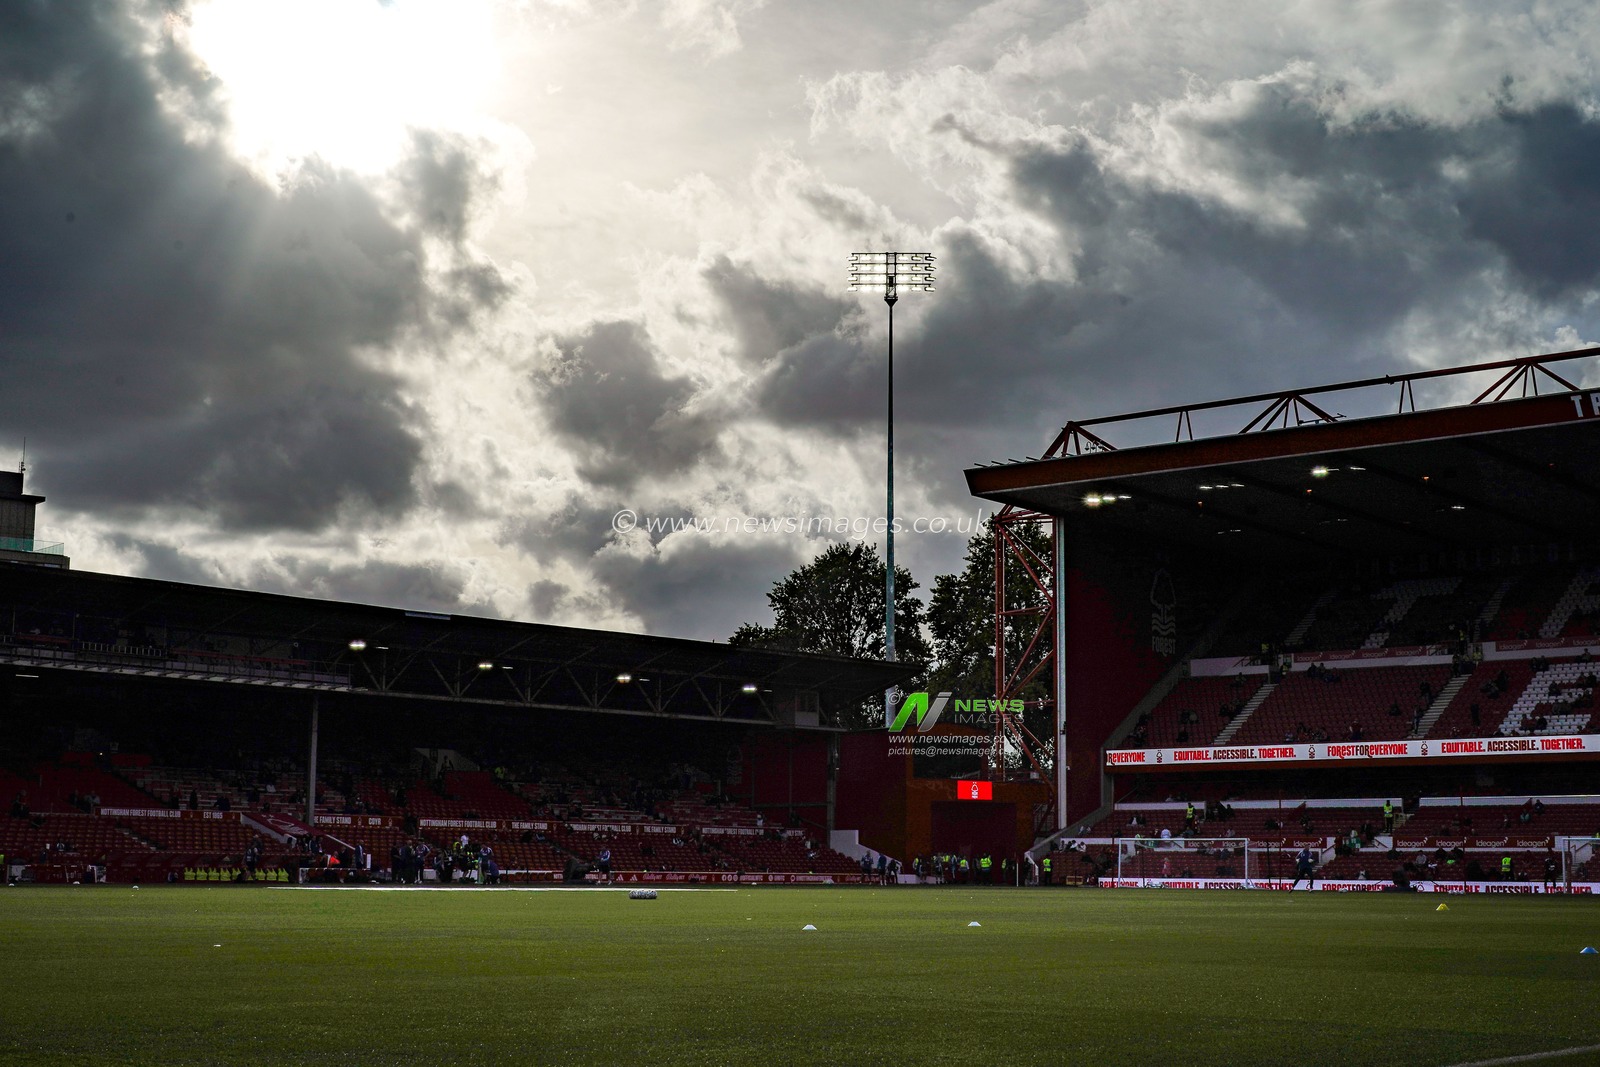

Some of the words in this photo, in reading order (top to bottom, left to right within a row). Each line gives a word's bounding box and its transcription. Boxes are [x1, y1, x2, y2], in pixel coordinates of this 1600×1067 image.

[1441, 741, 1486, 754] EQUITABLE.
[1487, 740, 1539, 752] ACCESSIBLE.
[1540, 738, 1586, 750] TOGETHER.
[1173, 750, 1212, 761] EQUITABLE.
[1213, 749, 1257, 760] ACCESSIBLE.
[1258, 747, 1297, 759] TOGETHER.
[100, 808, 130, 817] NOTTINGHAM
[130, 809, 147, 817] FOREST
[147, 809, 169, 818] FOOTBALL
[169, 810, 181, 818] CLUB
[203, 811, 212, 819] EST
[319, 816, 336, 824] FAMILY
[336, 817, 352, 825] STAND
[447, 820, 464, 828] FOREST
[1397, 839, 1425, 848] Ideagen
[1436, 839, 1464, 848] Ideagen
[1476, 839, 1505, 848] Ideagen
[1517, 839, 1546, 848] Ideagen
